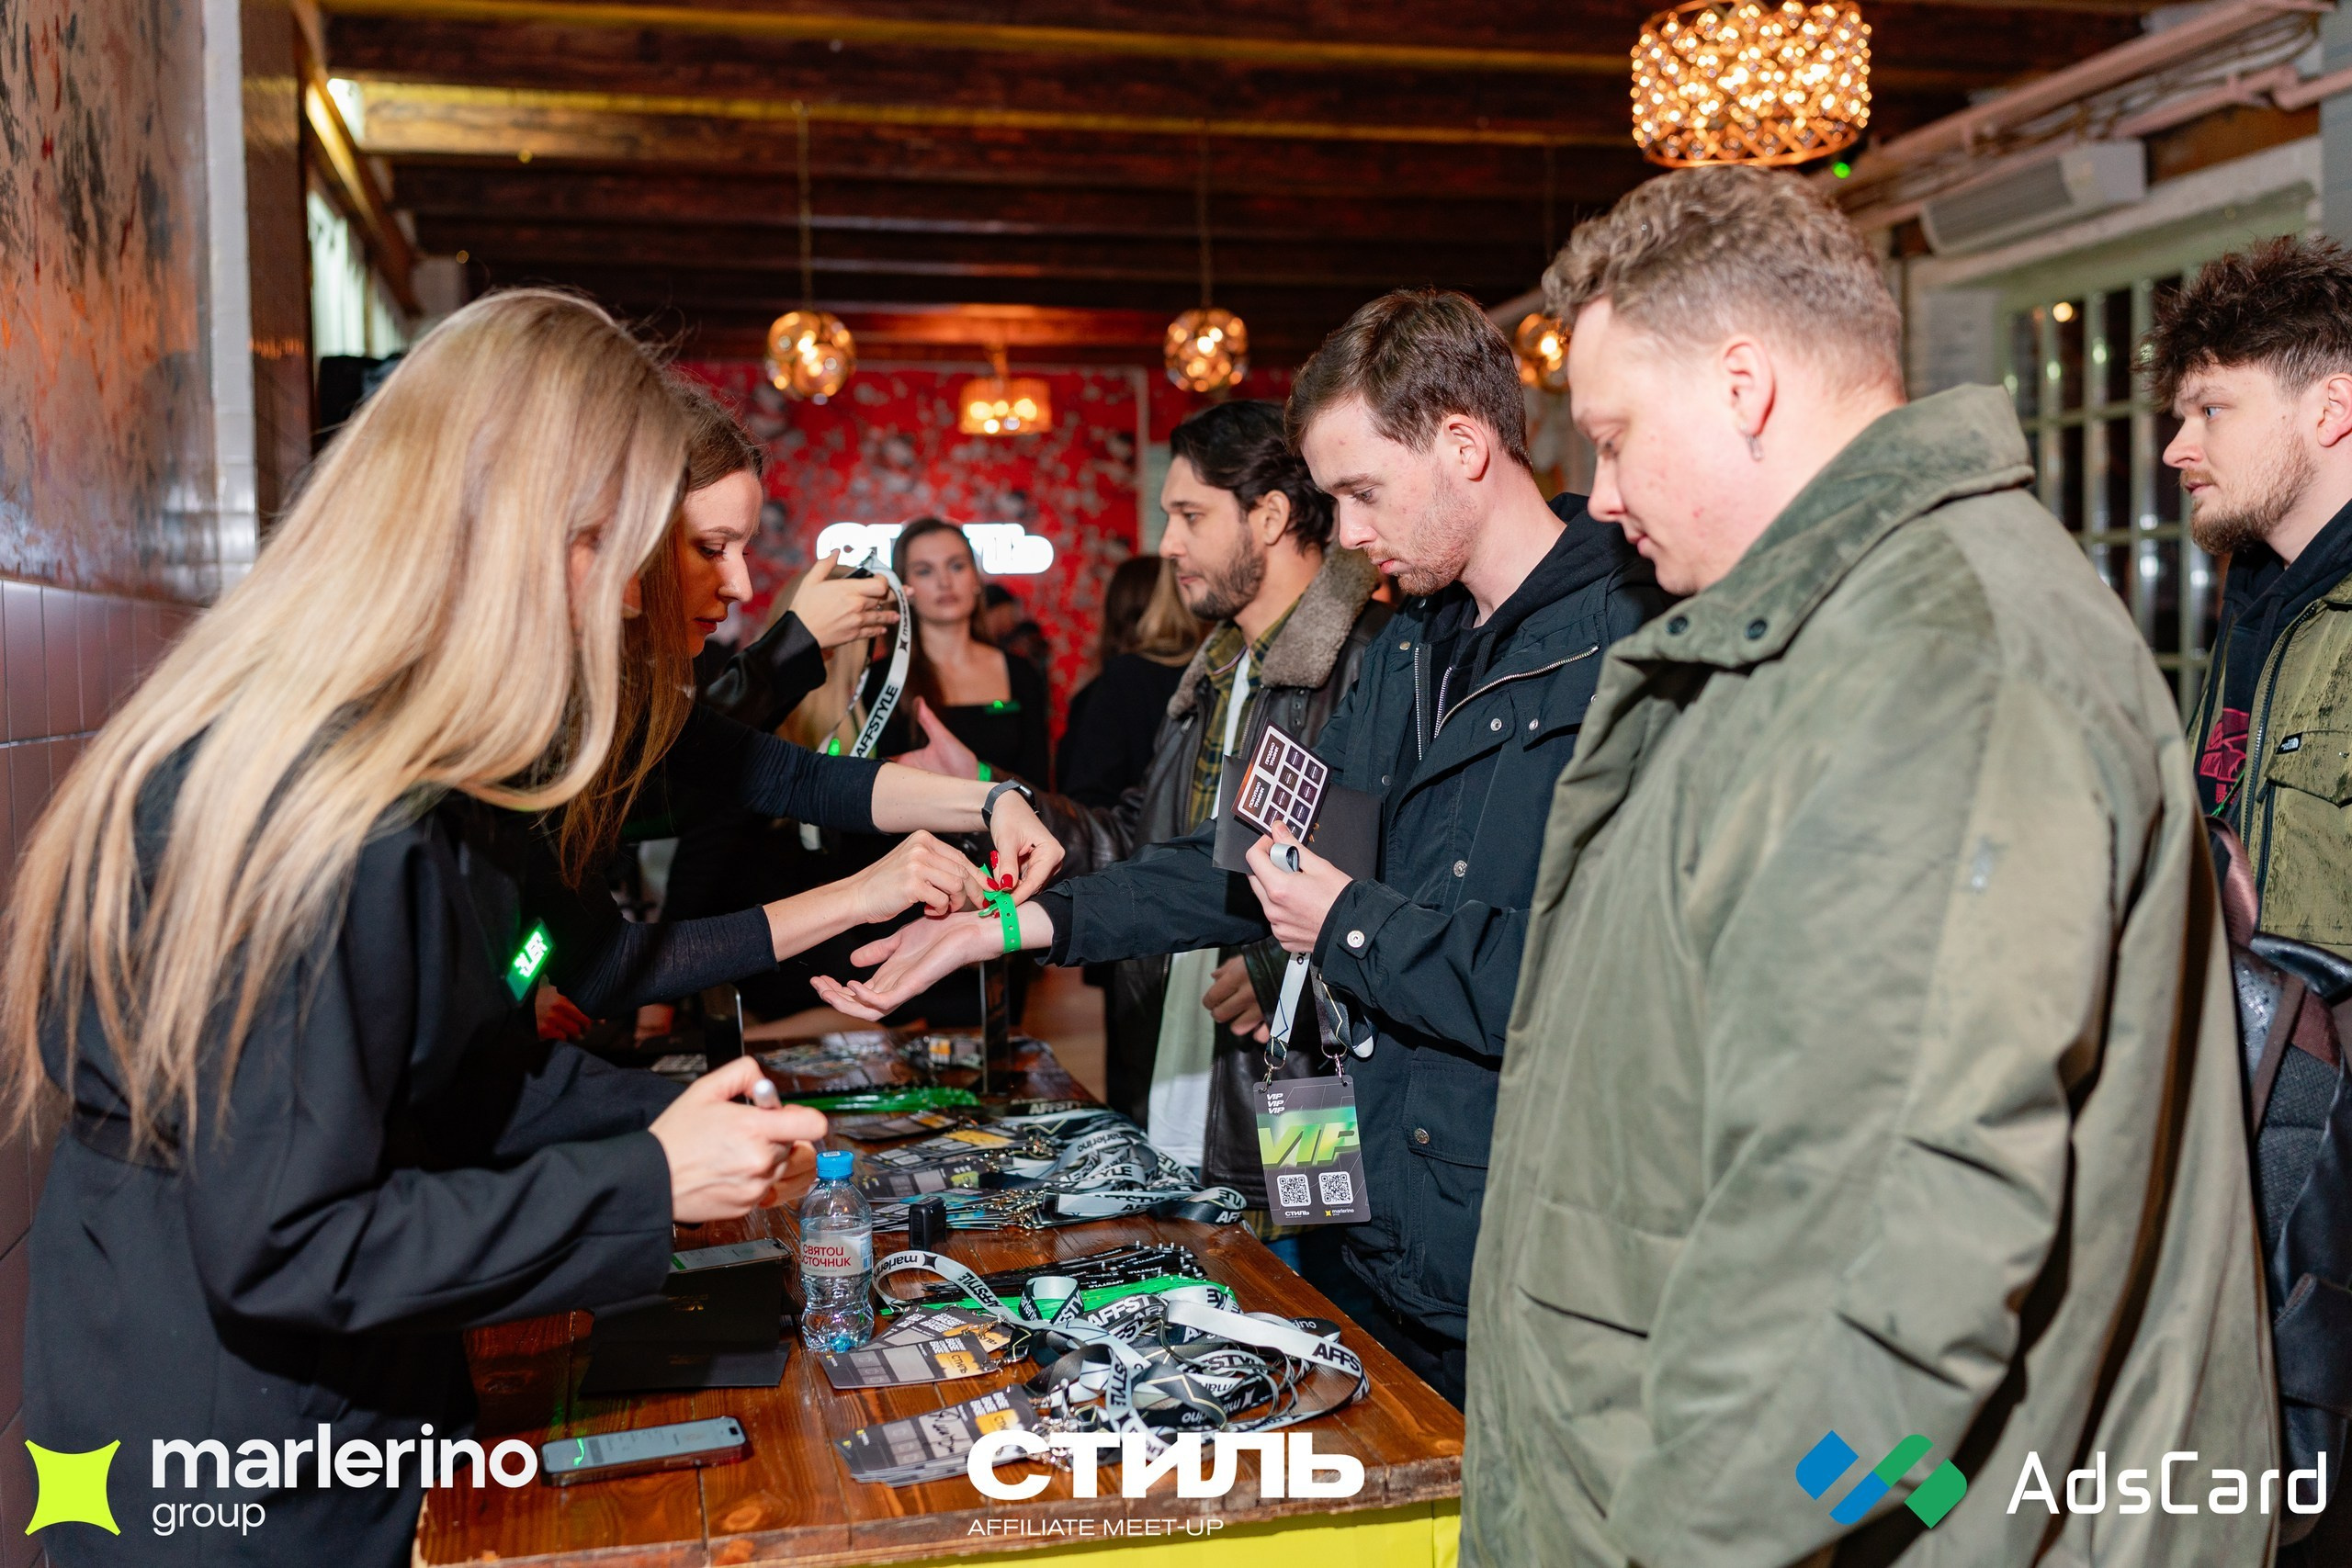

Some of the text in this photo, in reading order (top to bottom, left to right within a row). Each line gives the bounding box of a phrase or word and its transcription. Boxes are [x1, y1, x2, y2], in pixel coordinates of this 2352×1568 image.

[857, 685, 898, 758] AFFSTYLE
[1267, 1100, 1284, 1108] VIP
[1258, 1122, 1360, 1167] VIP
[802, 1255, 852, 1267] СТОЧНИК
[958, 1271, 1003, 1308] AFFSTYLE
[1087, 1295, 1150, 1328] AFFST
[1312, 1342, 1362, 1372] AFFS
[1110, 1362, 1128, 1405] STYLE
